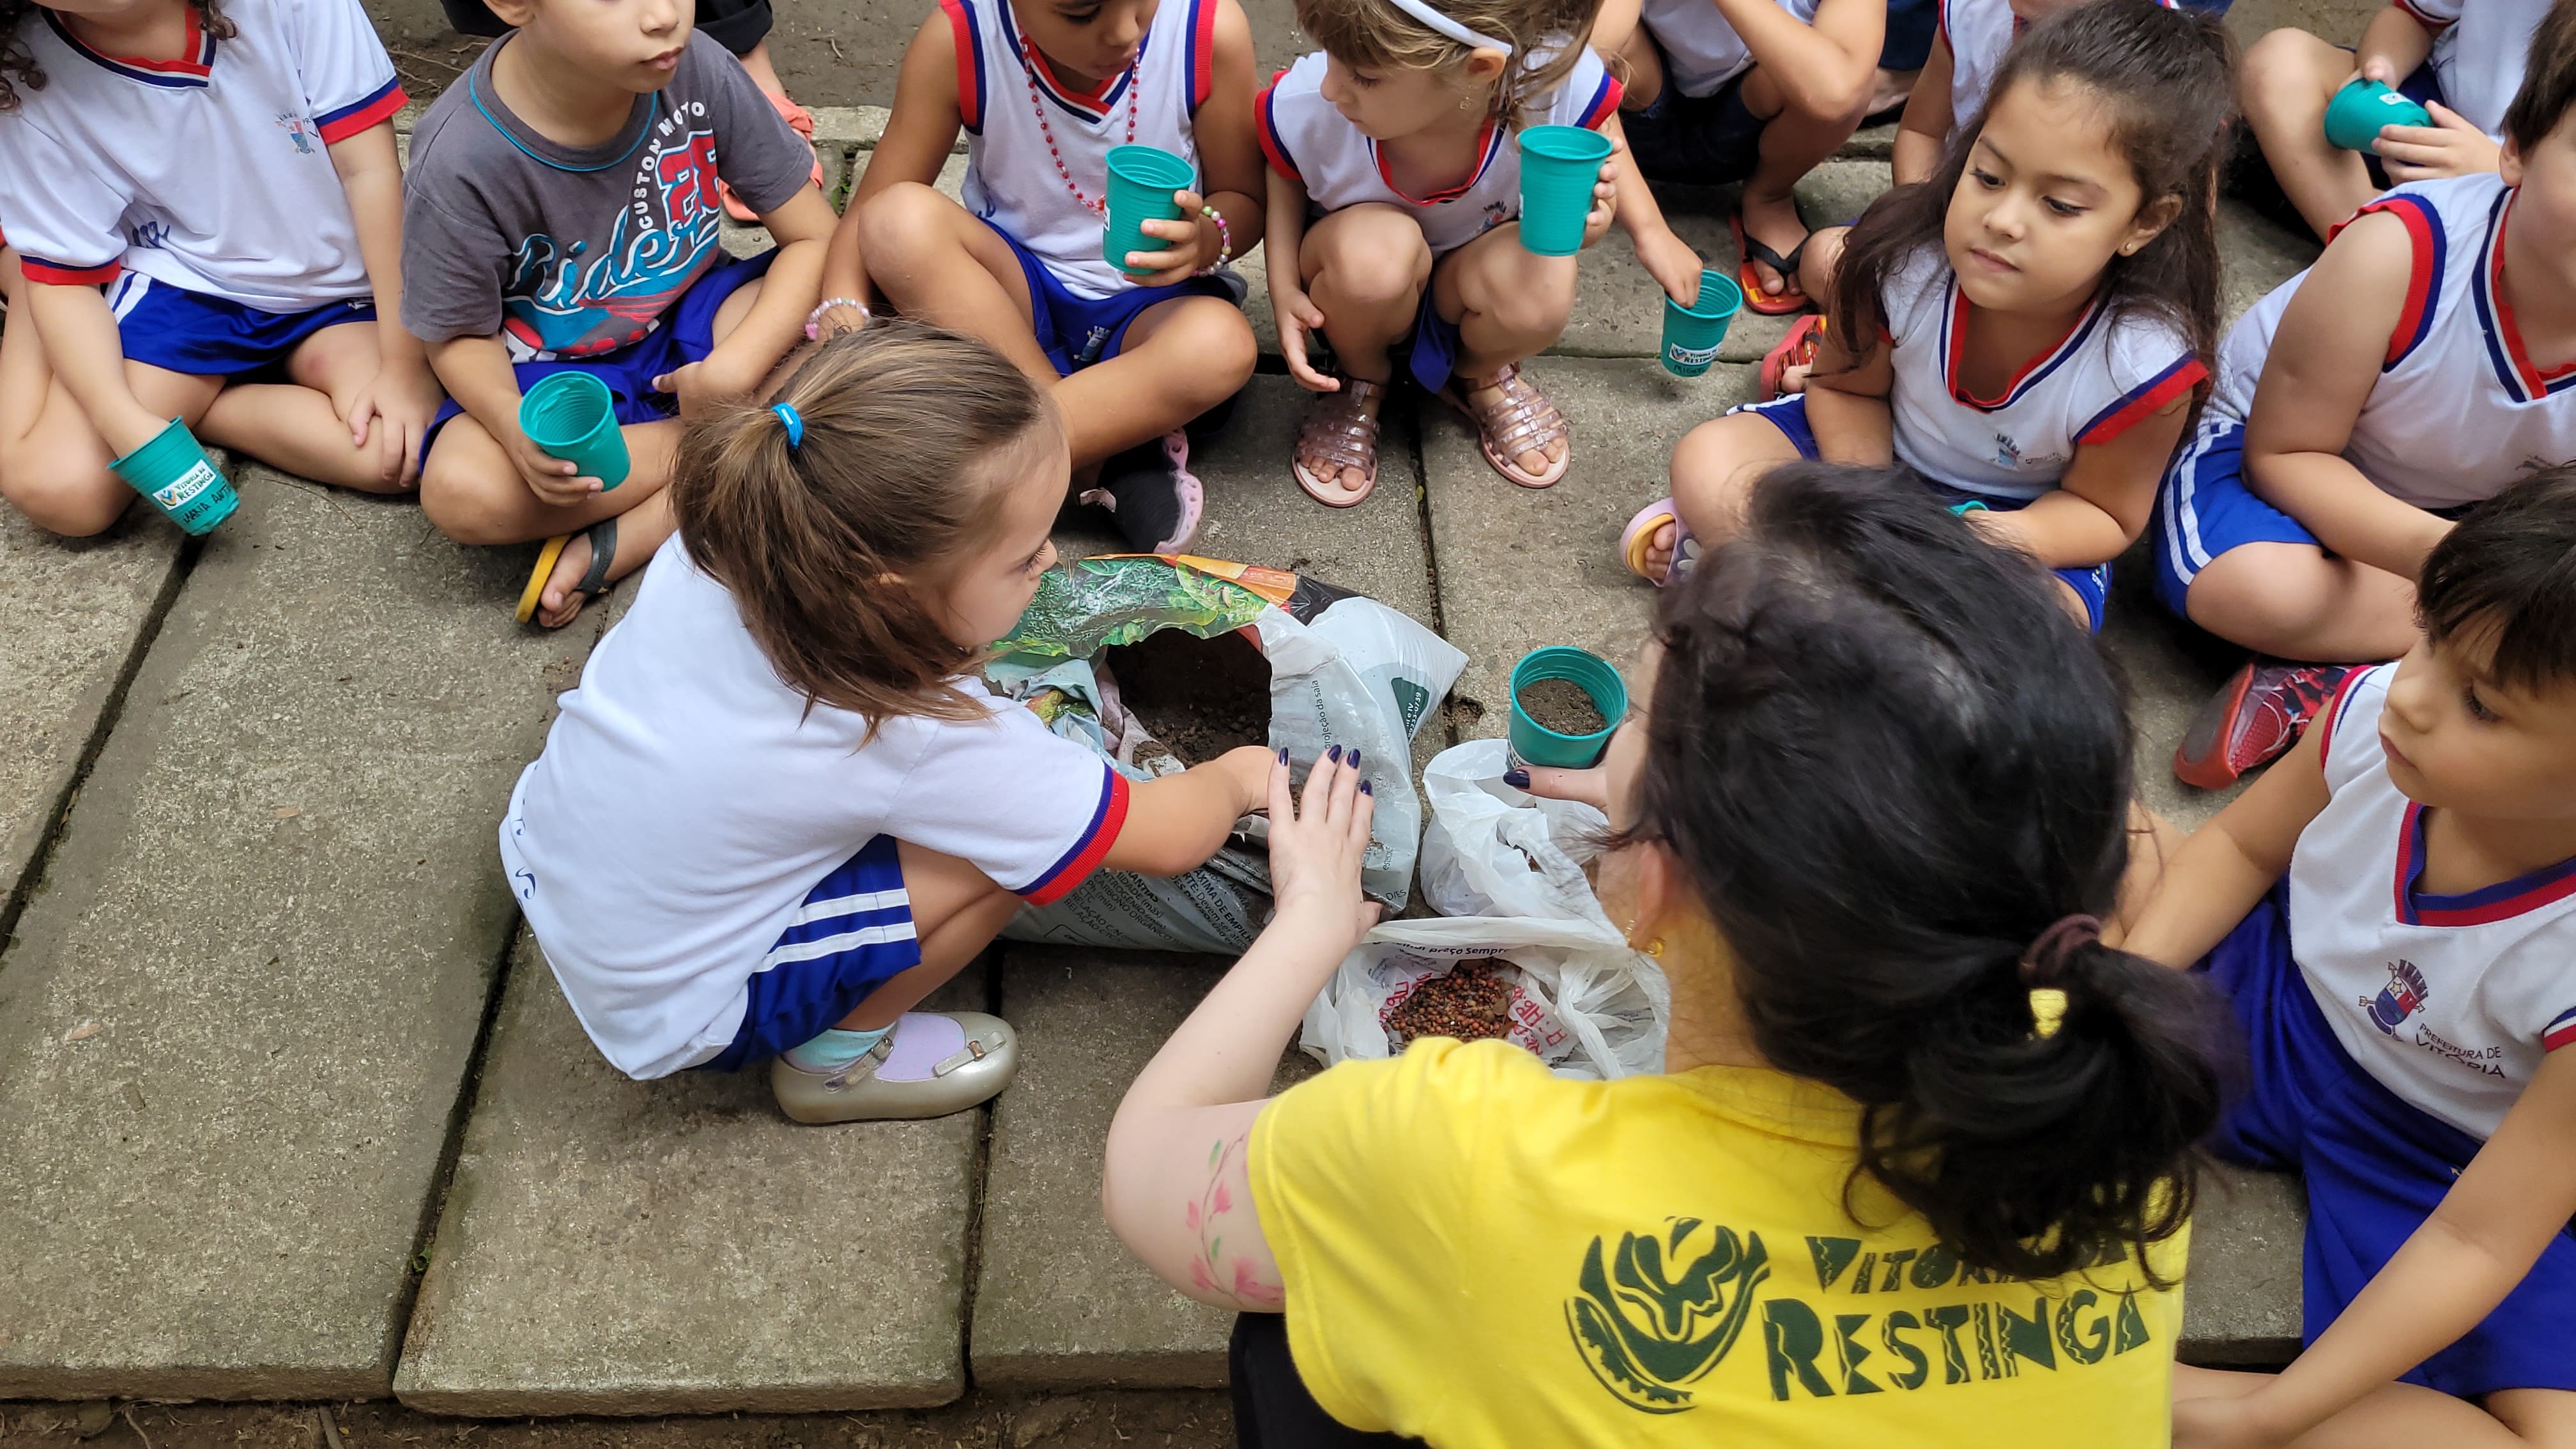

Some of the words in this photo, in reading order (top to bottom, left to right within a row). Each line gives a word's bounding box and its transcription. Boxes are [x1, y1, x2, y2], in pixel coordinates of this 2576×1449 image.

[633, 138, 662, 229] CUSTON
[658, 102, 710, 137] MOTO
[507, 205, 719, 309] Rider
[176, 472, 213, 501] RESTINGA
[1311, 680, 1322, 698] saia
[1315, 698, 1324, 710] da
[1078, 887, 1096, 903] CTC
[1086, 880, 1096, 893] Ph
[1093, 874, 1130, 912] CARBONO
[1183, 873, 1199, 893] RTE:
[1197, 892, 1220, 922] Devem
[1219, 920, 1231, 932] ser
[1214, 898, 1227, 914] DE
[1224, 913, 1254, 942] EMPILH
[2419, 1023, 2483, 1060] PREFEITURA
[2487, 1046, 2503, 1059] DE
[1761, 1279, 2150, 1402] RESTINGA
